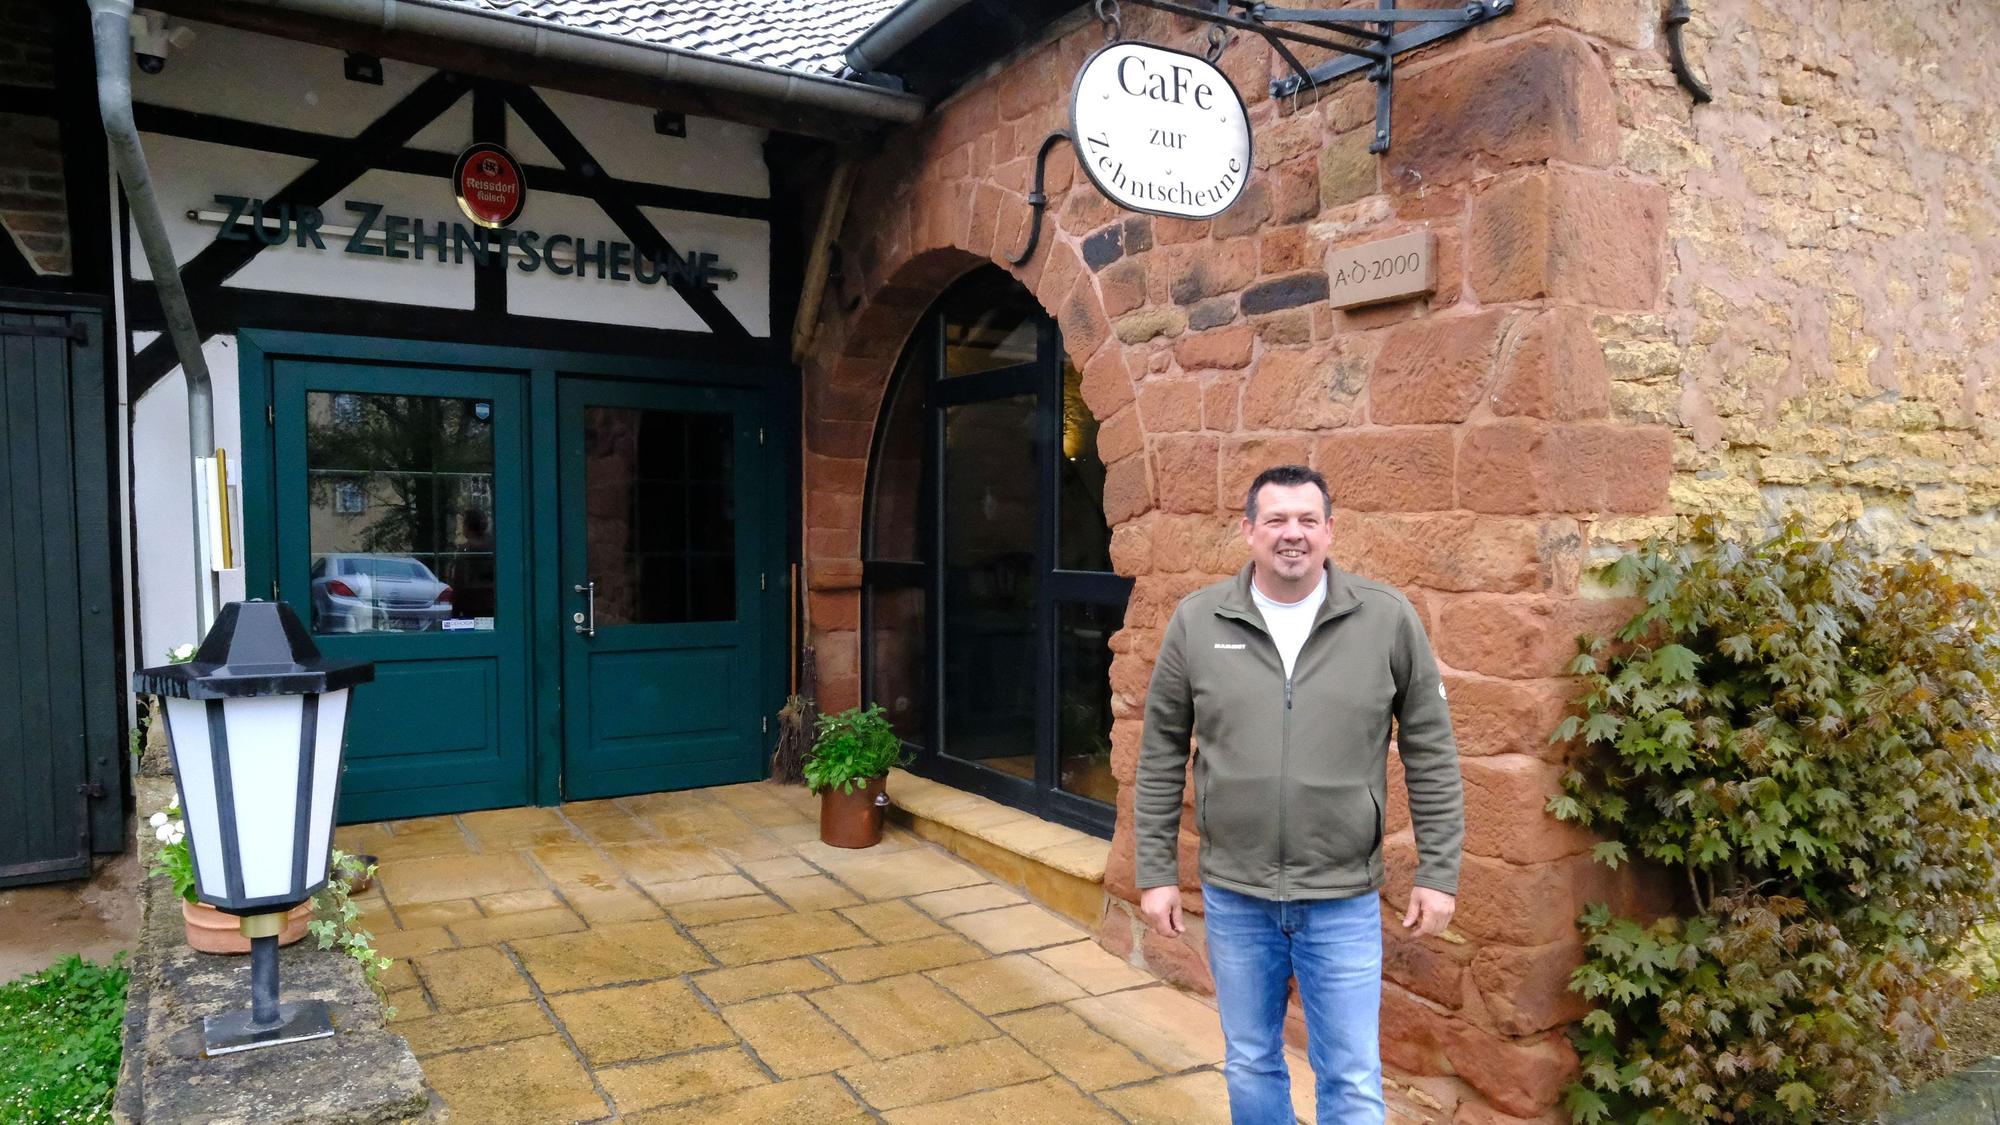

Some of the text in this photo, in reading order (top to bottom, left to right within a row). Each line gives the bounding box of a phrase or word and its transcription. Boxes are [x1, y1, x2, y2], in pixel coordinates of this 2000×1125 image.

[1117, 55, 1213, 110] CaFe
[1149, 128, 1187, 149] zur
[466, 177, 516, 194] Reissdorf
[1087, 132, 1241, 207] Zehntscheune
[214, 194, 719, 291] ZUR ZEHNTSCHEUNE
